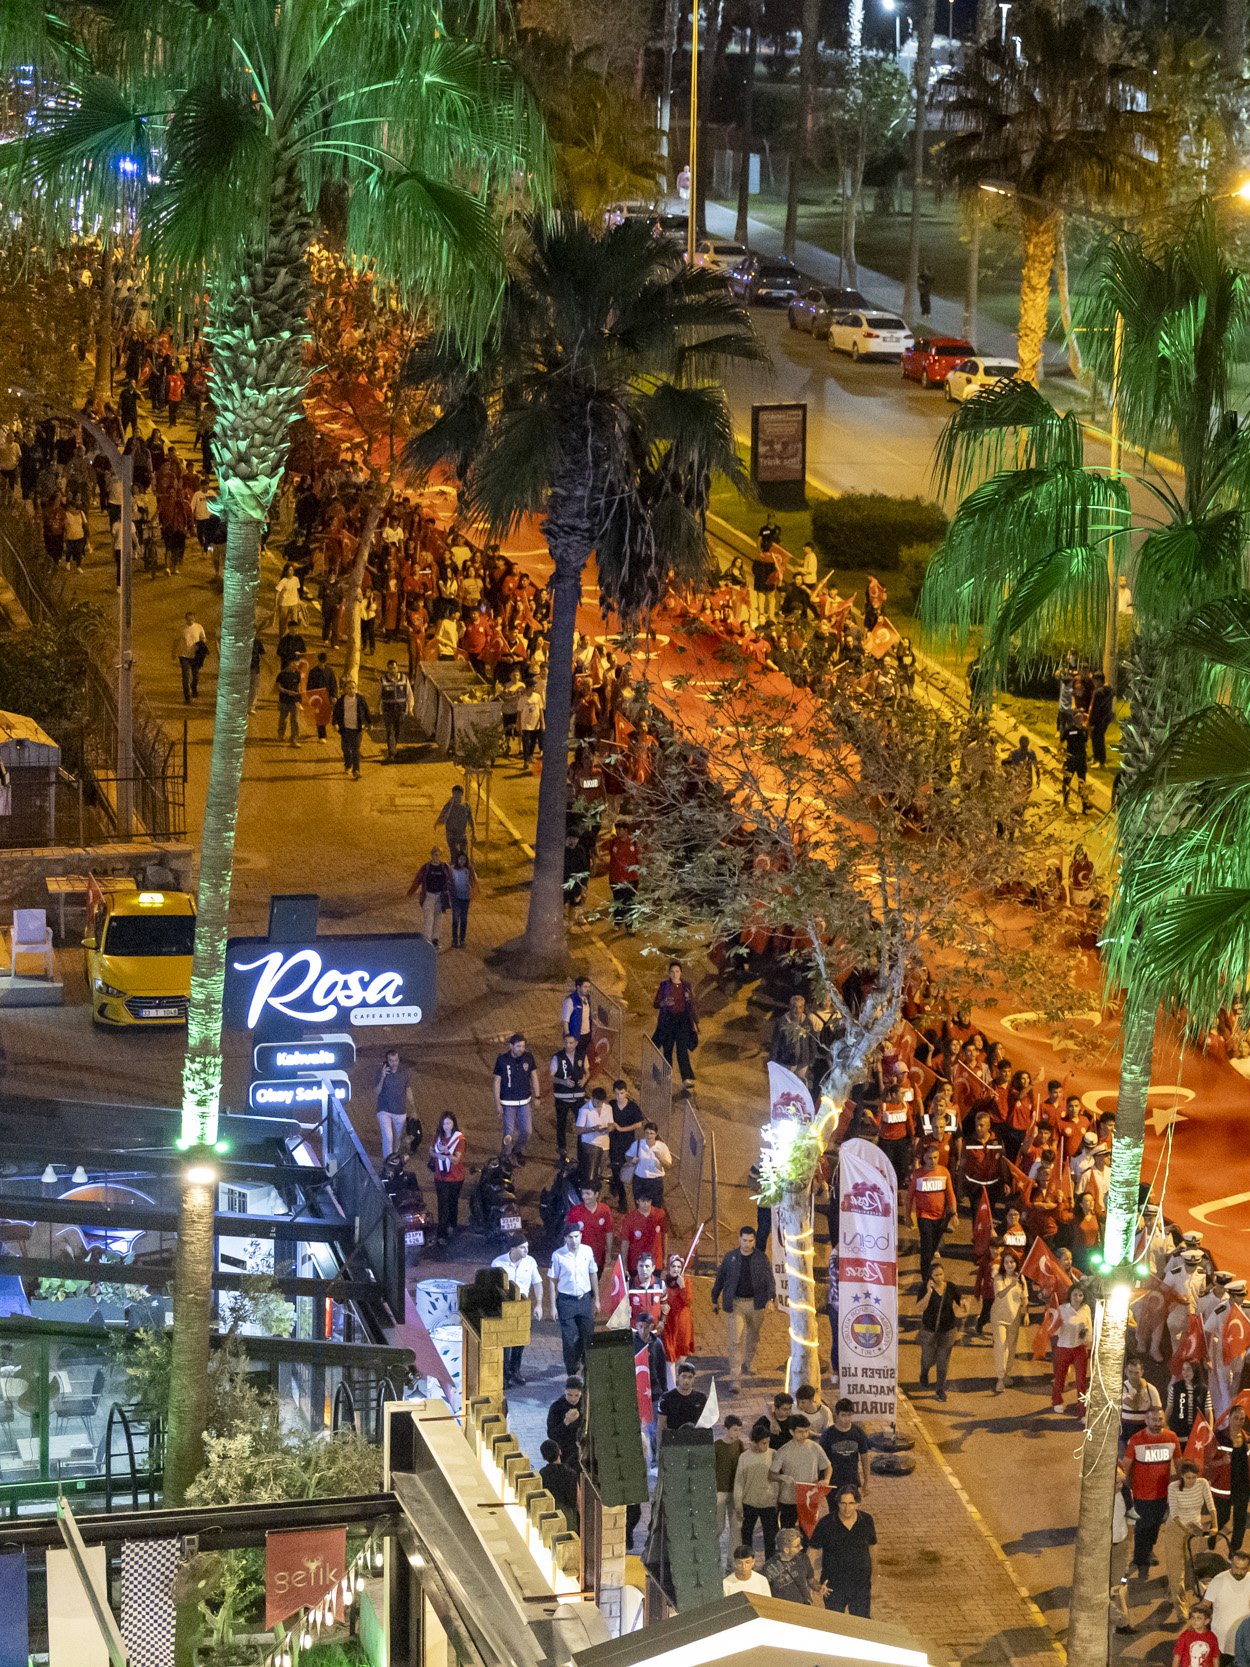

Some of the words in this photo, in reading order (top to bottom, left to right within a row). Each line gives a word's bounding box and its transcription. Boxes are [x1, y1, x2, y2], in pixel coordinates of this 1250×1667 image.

[233, 949, 404, 1029] Rosa
[888, 1111, 907, 1124] AKUB
[921, 1180, 943, 1192] AKUB
[1144, 1448, 1170, 1462] AKUB
